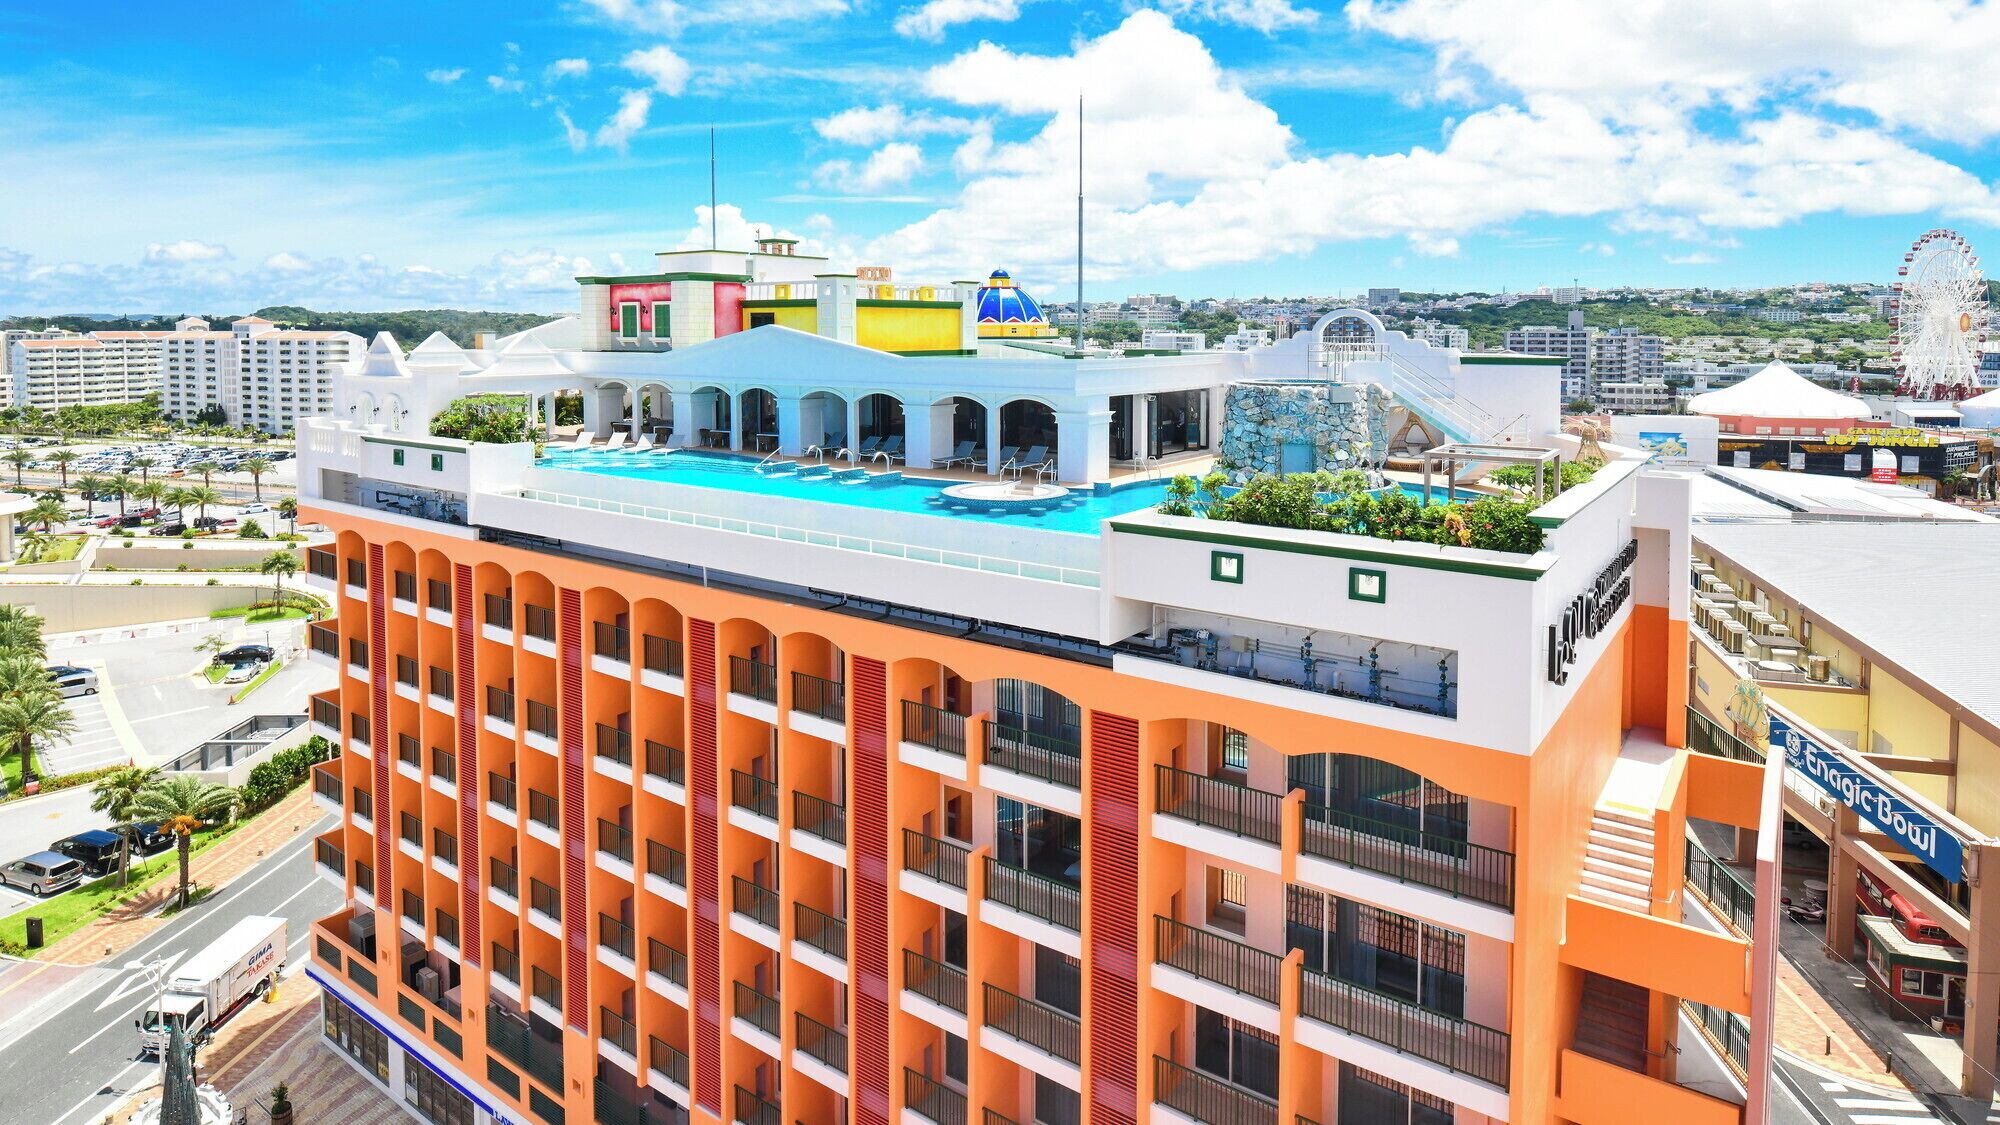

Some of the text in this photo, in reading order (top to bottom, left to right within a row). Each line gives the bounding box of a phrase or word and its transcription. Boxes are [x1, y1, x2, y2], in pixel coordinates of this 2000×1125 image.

[1825, 434, 1940, 448] JOY JUNGLE
[1806, 742, 1936, 859] Enagic Bowl
[247, 951, 274, 978] TAKASE
[248, 943, 273, 966] GIMA
